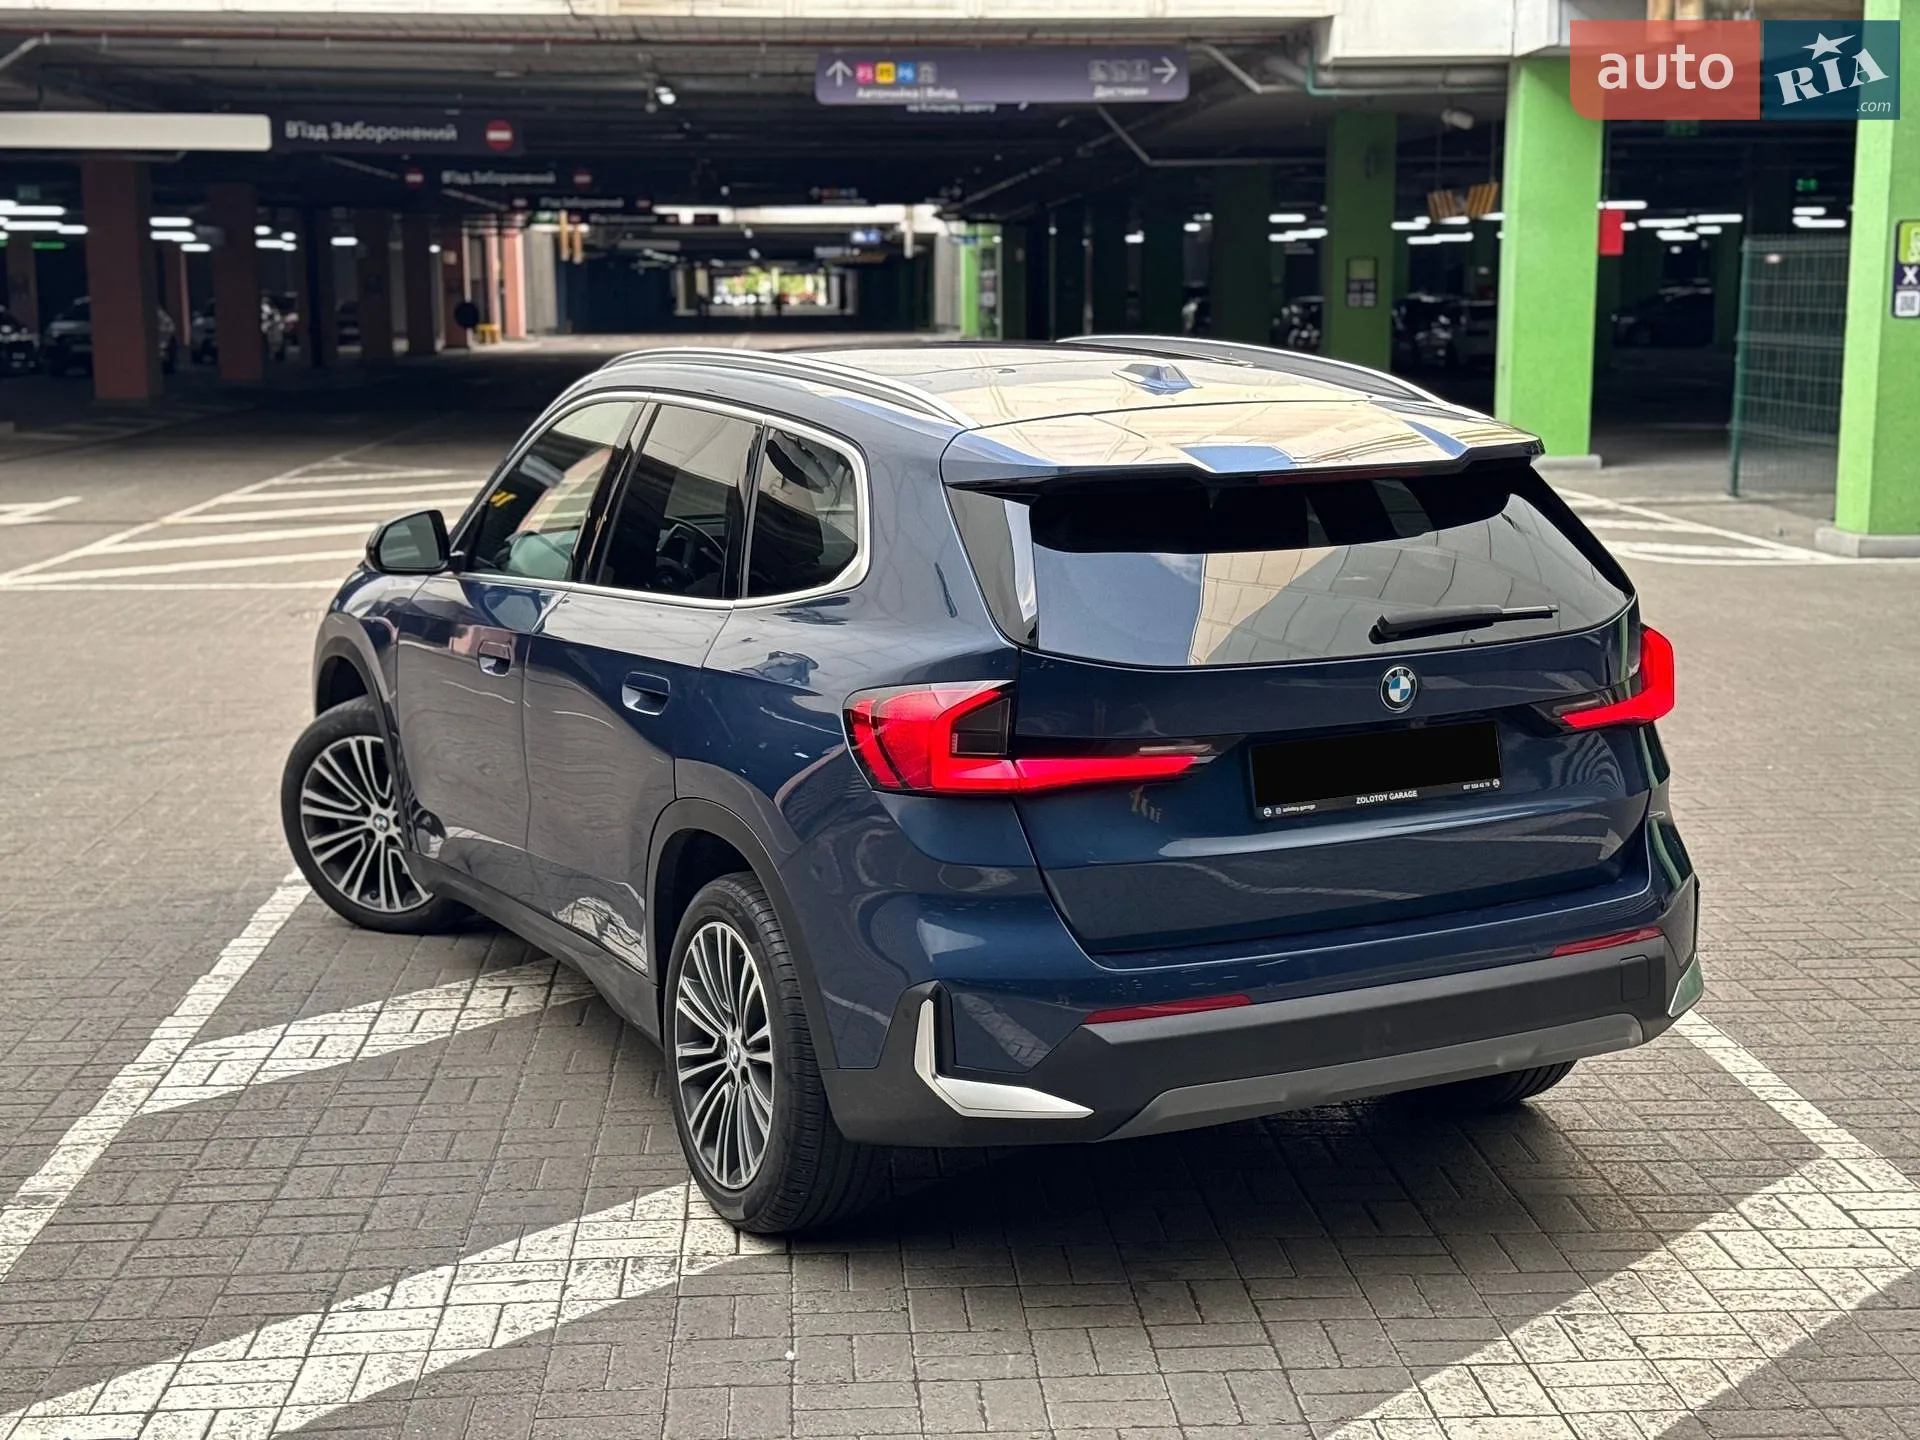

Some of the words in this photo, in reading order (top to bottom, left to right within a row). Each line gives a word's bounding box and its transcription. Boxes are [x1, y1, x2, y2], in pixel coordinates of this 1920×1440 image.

[331, 121, 457, 143] Заборонений
[1385, 668, 1415, 684] BMW
[1356, 794, 1388, 804] ZOLOTOY
[1389, 790, 1418, 800] GARAGE
